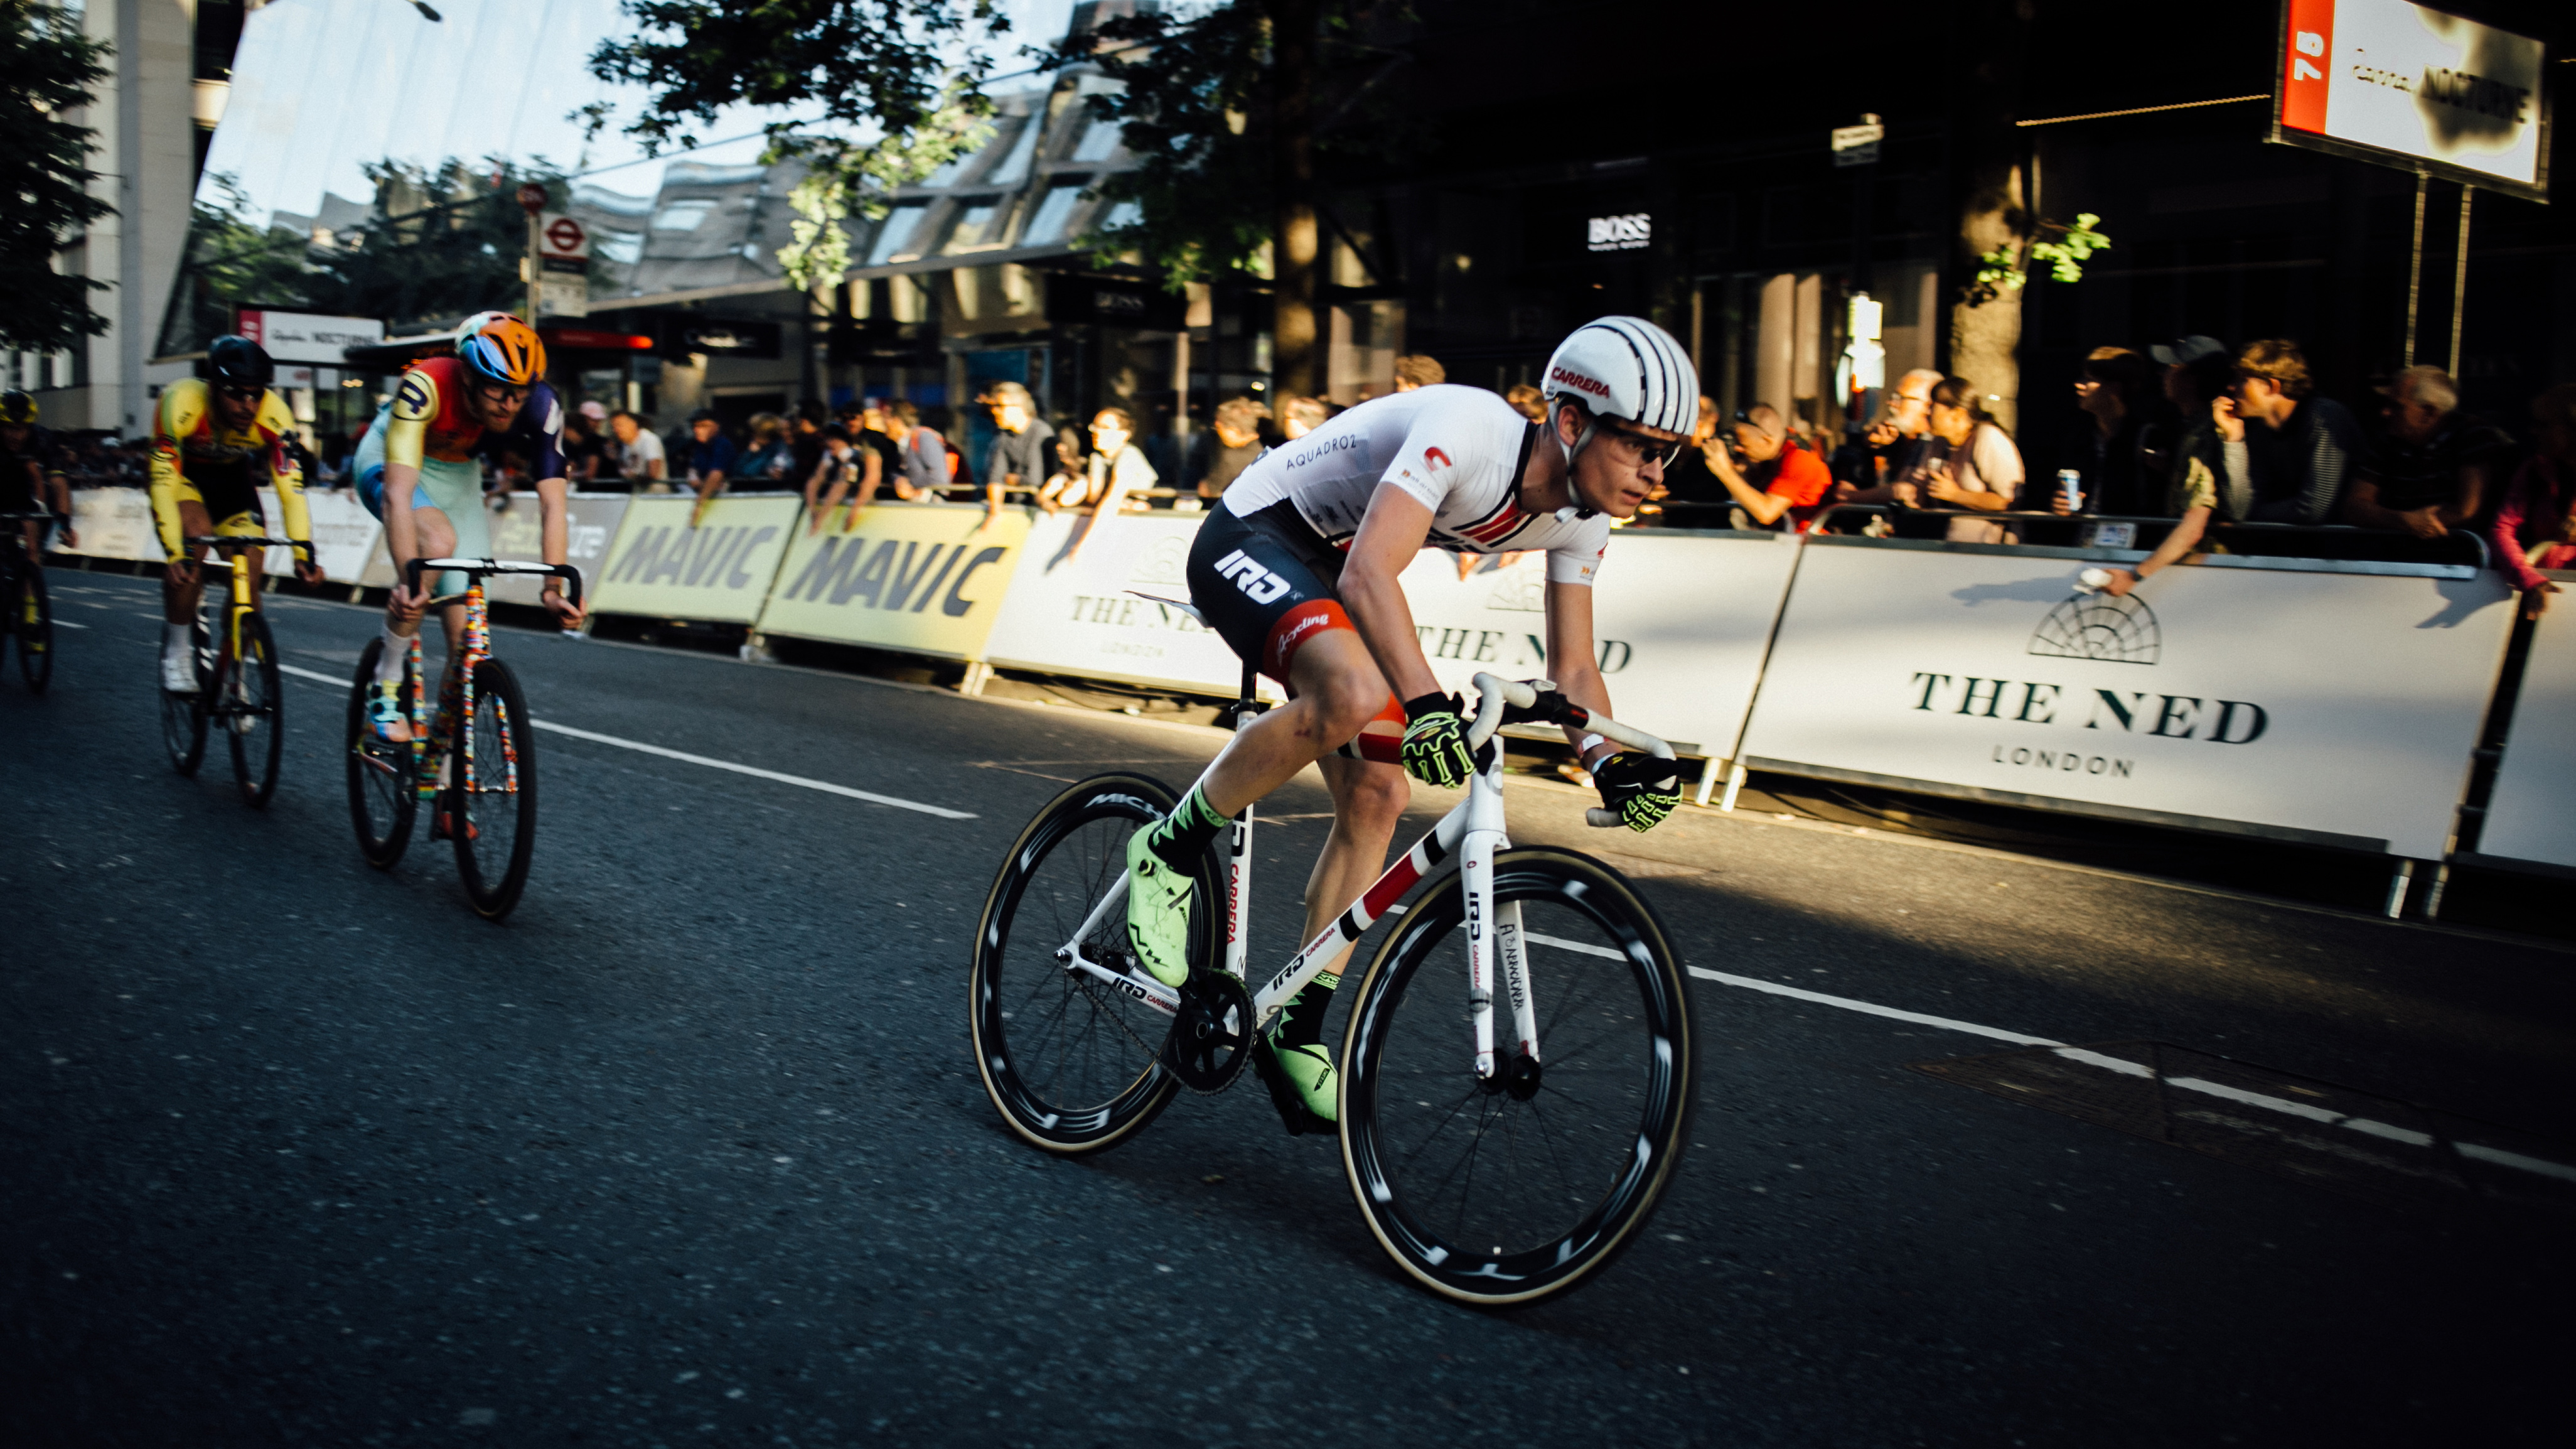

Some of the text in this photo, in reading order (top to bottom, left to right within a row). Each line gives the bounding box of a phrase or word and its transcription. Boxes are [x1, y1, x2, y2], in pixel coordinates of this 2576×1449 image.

[1588, 213, 1651, 244] BOSS
[1551, 366, 1610, 399] CARRERA
[1287, 434, 1356, 471] AQUADRO2
[607, 525, 779, 590] MAVIC
[783, 535, 1009, 618] MAVIC
[1214, 549, 1291, 605] IRD
[1071, 596, 1141, 627] THE
[1416, 626, 1633, 674] THE ND
[1912, 672, 2268, 745] THE NED
[1992, 745, 2135, 779] LONDON
[1227, 863, 1239, 944] CARRERA
[1468, 891, 1481, 941] IRD
[1273, 927, 1335, 991] IRD CARRERA
[1112, 977, 1178, 1013] IRD CARRERA
